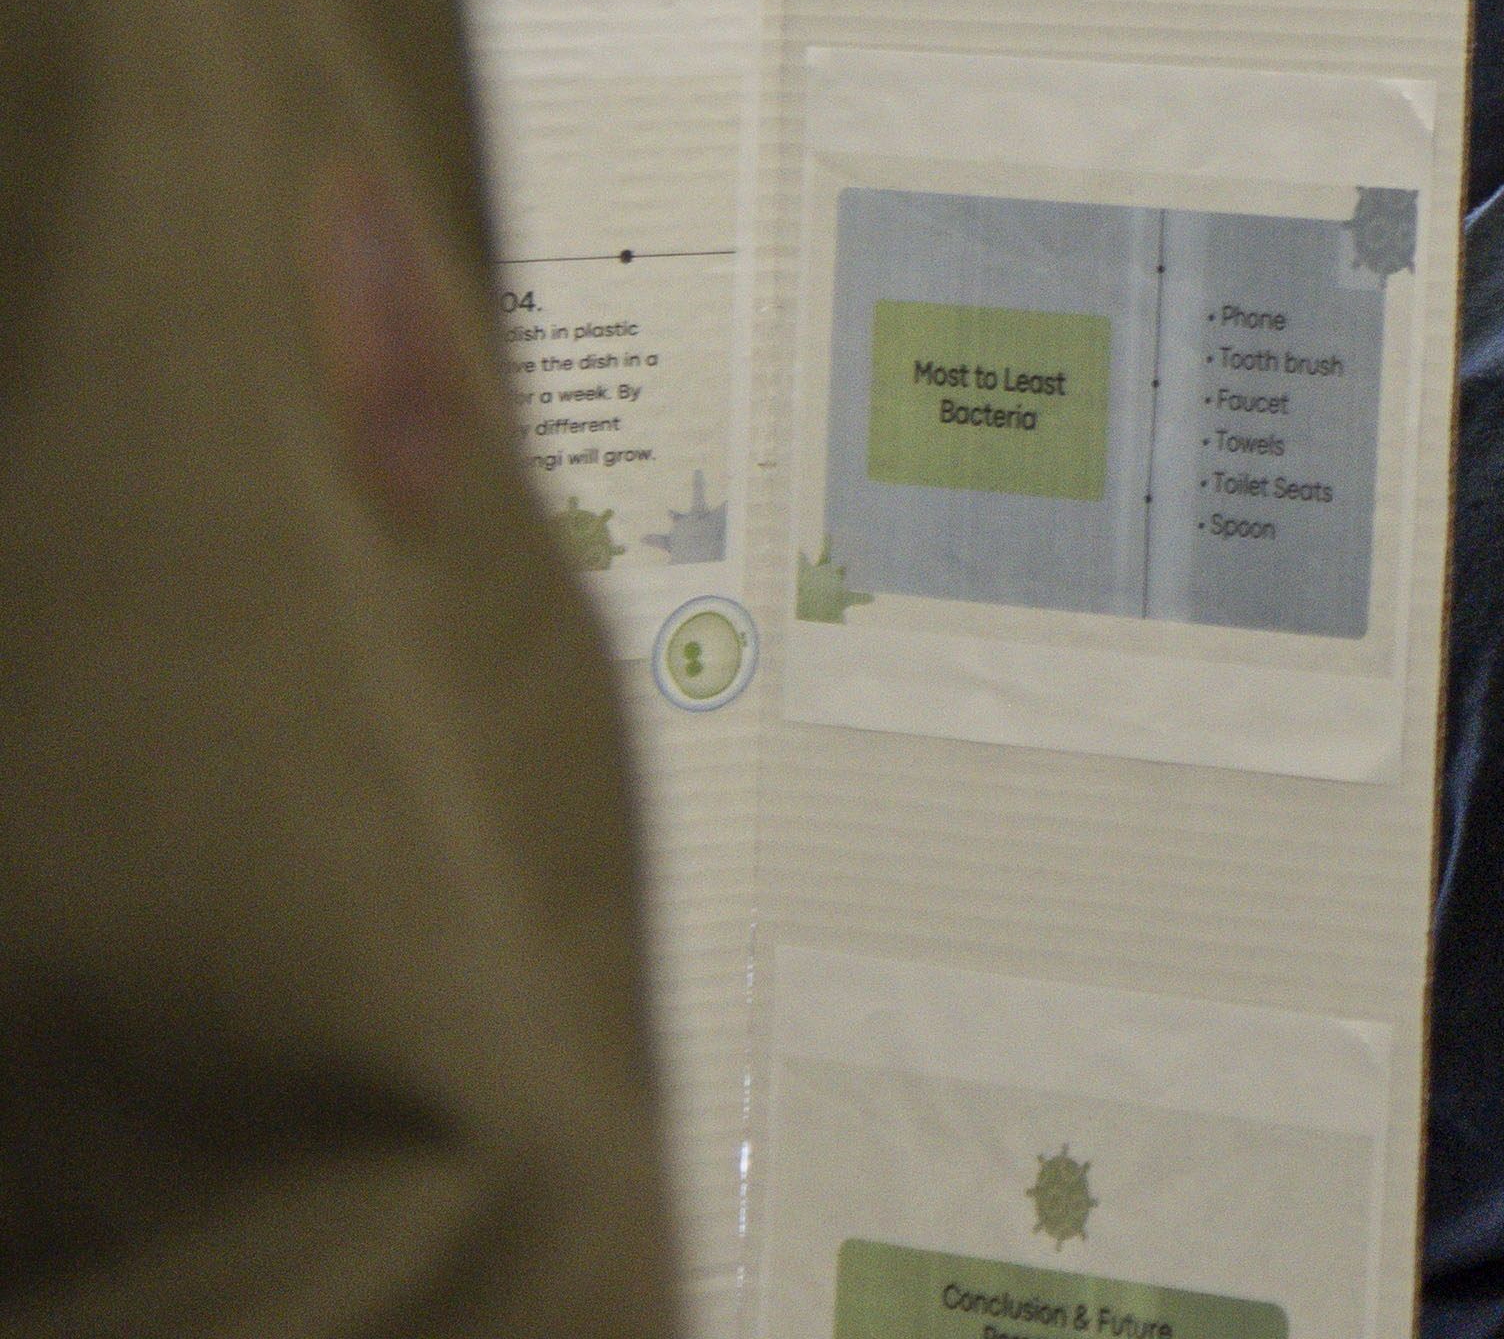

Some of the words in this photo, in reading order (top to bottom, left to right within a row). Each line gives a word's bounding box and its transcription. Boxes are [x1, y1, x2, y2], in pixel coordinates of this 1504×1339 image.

[551, 324, 569, 340] in
[574, 321, 639, 342] plastic
[1221, 305, 1288, 331] Phone
[541, 355, 574, 372] the
[578, 353, 619, 370] dish
[623, 351, 641, 368] in
[645, 353, 659, 368] a
[1219, 346, 1279, 373] Tooth
[1284, 350, 1344, 378] brush
[913, 359, 969, 390] Most
[974, 365, 998, 391] to
[1003, 368, 1067, 397] Least
[539, 391, 553, 404] a
[617, 383, 643, 403] By
[1217, 388, 1289, 416] Faucet
[535, 417, 621, 436] different
[939, 399, 1038, 431] Bacteria
[568, 448, 599, 465] will
[1215, 430, 1286, 457] Towels
[1212, 471, 1270, 499] Toilet
[1275, 476, 1334, 504] Seats
[1209, 513, 1277, 541] Spoon
[942, 1282, 1067, 1328] Conclusion
[1072, 1303, 1090, 1331] &
[1098, 1305, 1173, 1339] Future
